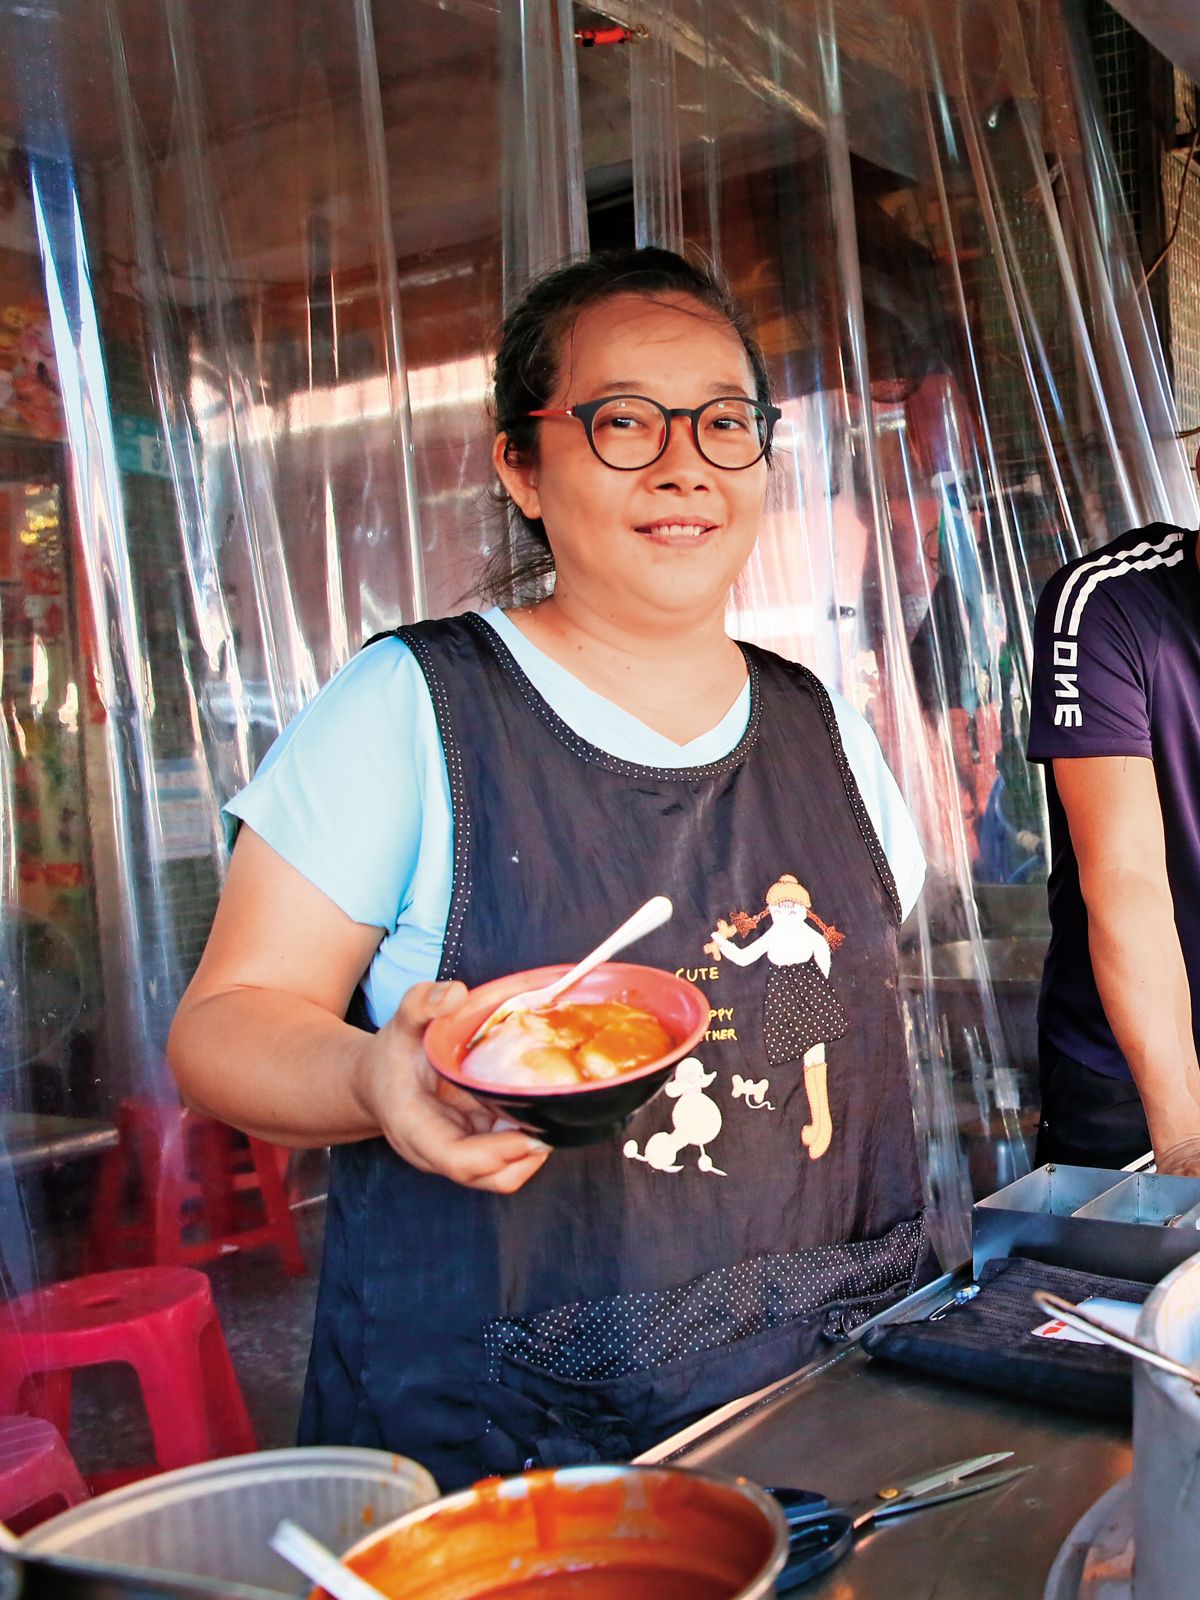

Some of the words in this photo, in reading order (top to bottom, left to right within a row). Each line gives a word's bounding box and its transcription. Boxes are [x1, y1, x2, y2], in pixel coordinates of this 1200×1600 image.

[675, 966, 719, 982] CUTE
[708, 1007, 733, 1022] PPY
[705, 1028, 737, 1041] THER
